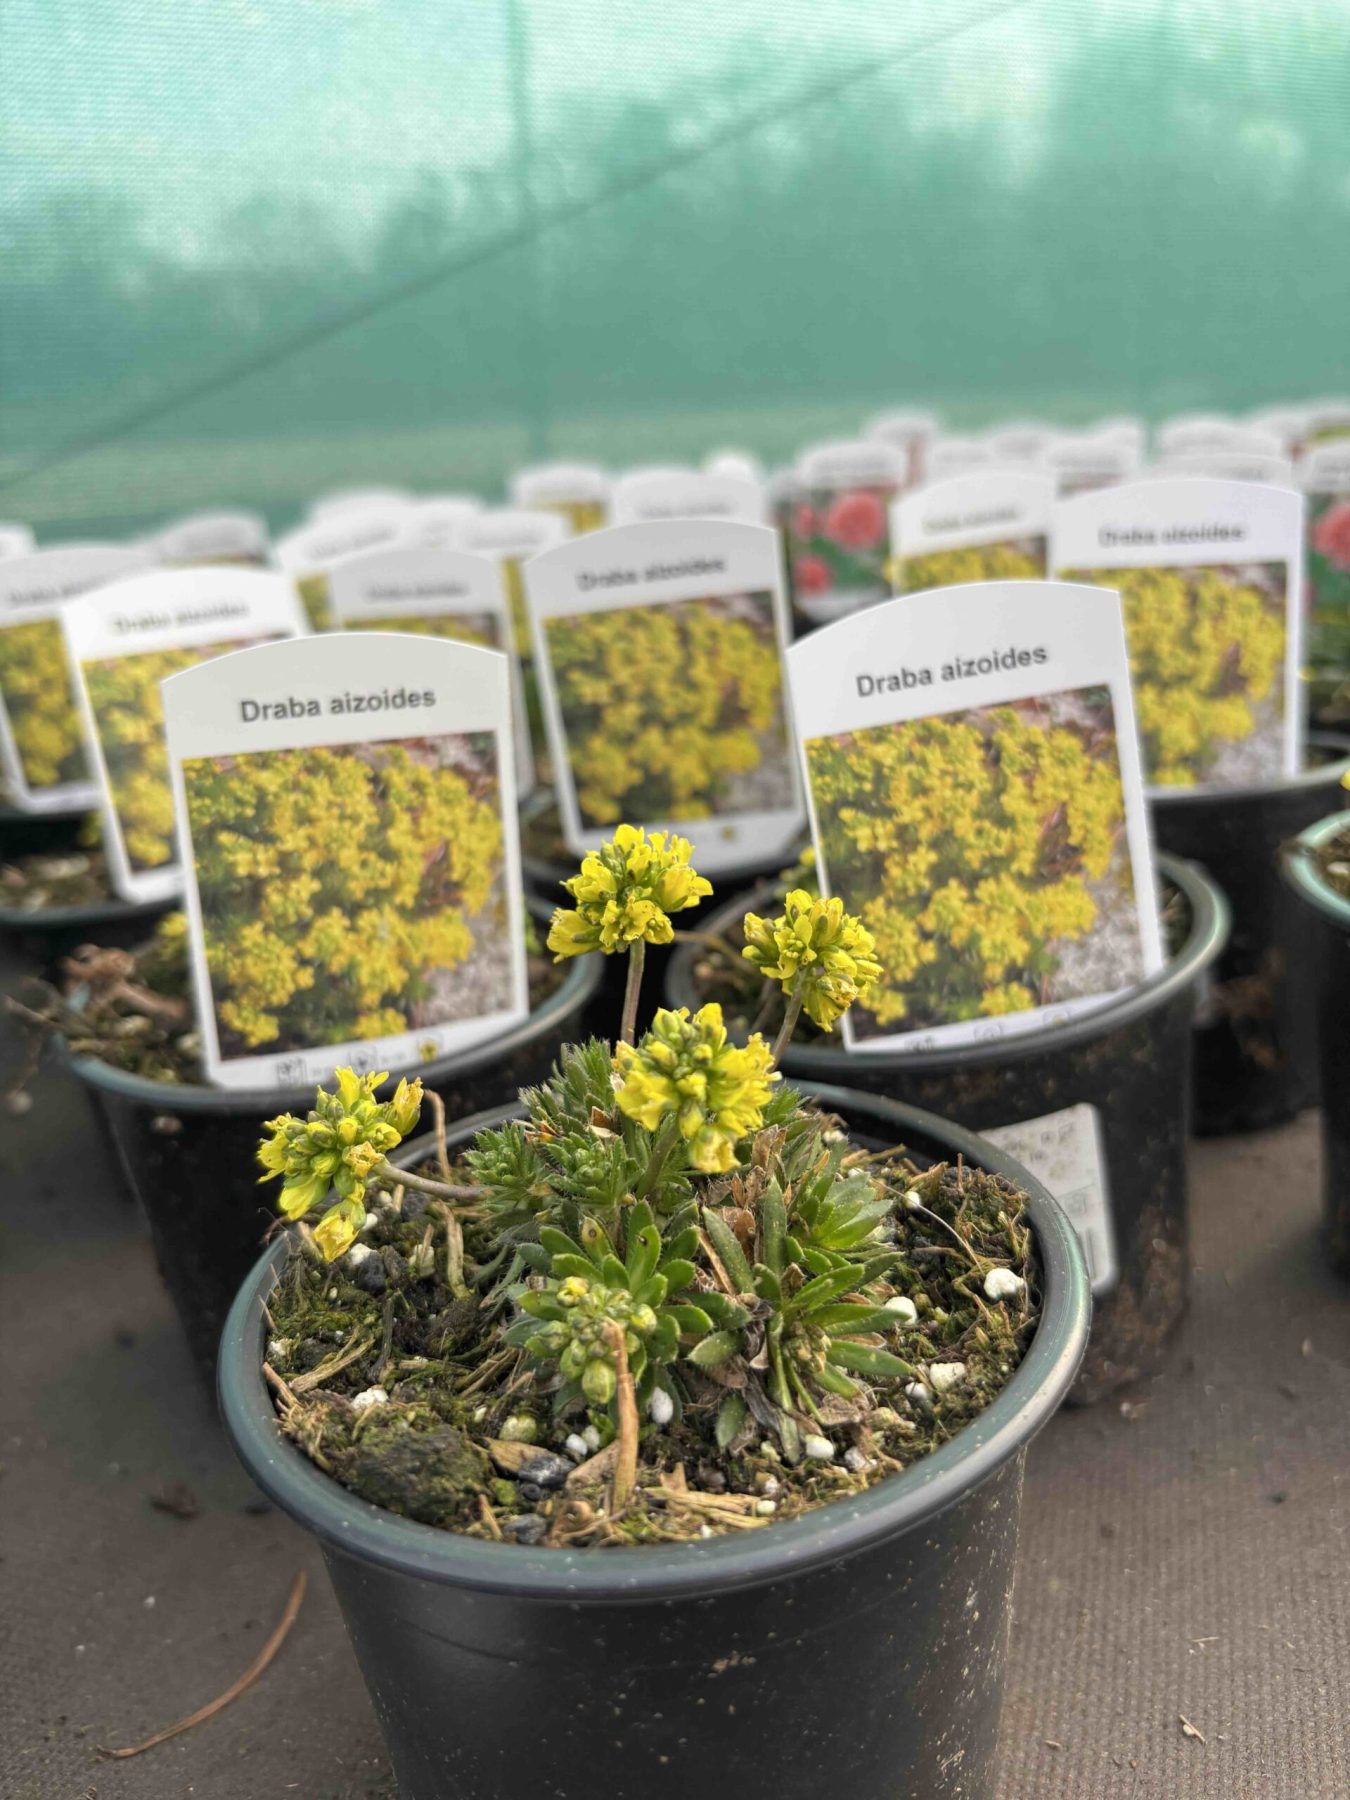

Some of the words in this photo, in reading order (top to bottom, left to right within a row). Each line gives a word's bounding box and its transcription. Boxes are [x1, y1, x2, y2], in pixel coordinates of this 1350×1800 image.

[855, 667, 933, 697] Draba
[940, 647, 1048, 682] aizoides
[240, 696, 321, 722] Draba
[330, 688, 436, 714] aizoides
